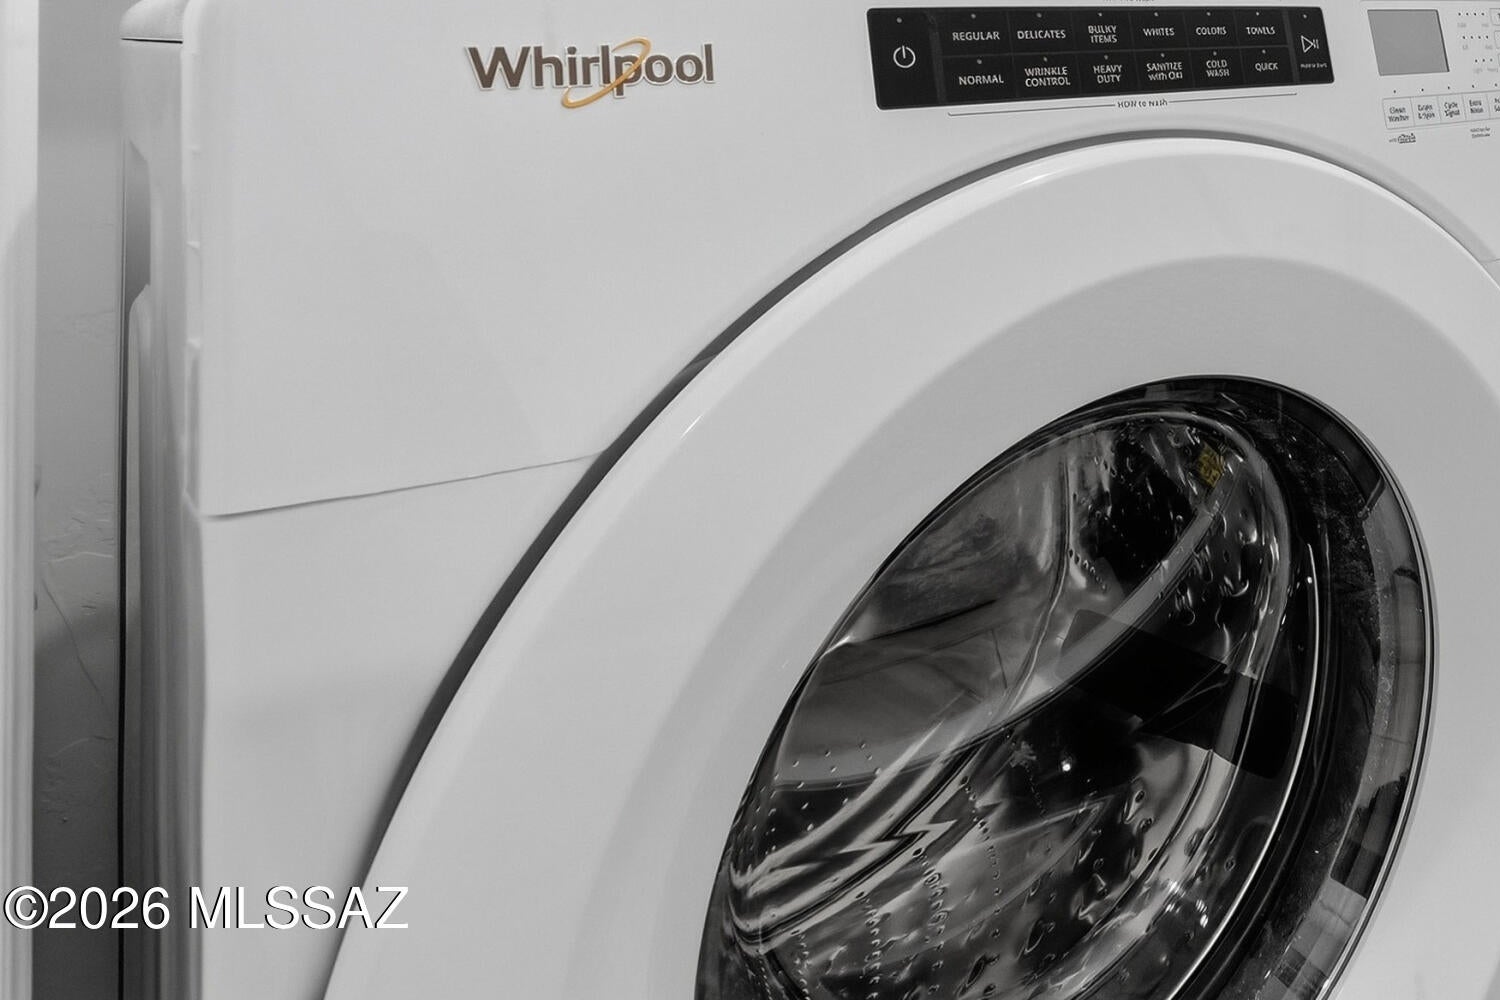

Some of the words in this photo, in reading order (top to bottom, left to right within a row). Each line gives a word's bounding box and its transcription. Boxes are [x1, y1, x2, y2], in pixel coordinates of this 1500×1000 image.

[1088, 25, 1117, 34] BULKY
[1143, 27, 1175, 36] WHITES
[1195, 26, 1227, 35] COLORS
[1245, 26, 1276, 35] TOWELS
[952, 31, 1000, 41] REGULAR
[1017, 30, 1066, 40] DELICATES
[1091, 34, 1118, 43] ITEMS
[1092, 64, 1122, 74] HEAVY
[1146, 62, 1183, 72] SANITIZE
[1206, 59, 1228, 69] COLD
[1254, 62, 1278, 72] QUICK
[464, 41, 716, 99] Whirlpool
[1024, 66, 1068, 77] WRINKLE
[1206, 68, 1230, 77] WASH
[958, 74, 1004, 85] NORMAL
[1025, 76, 1071, 87] CONTROL
[1096, 74, 1121, 84] DUTY
